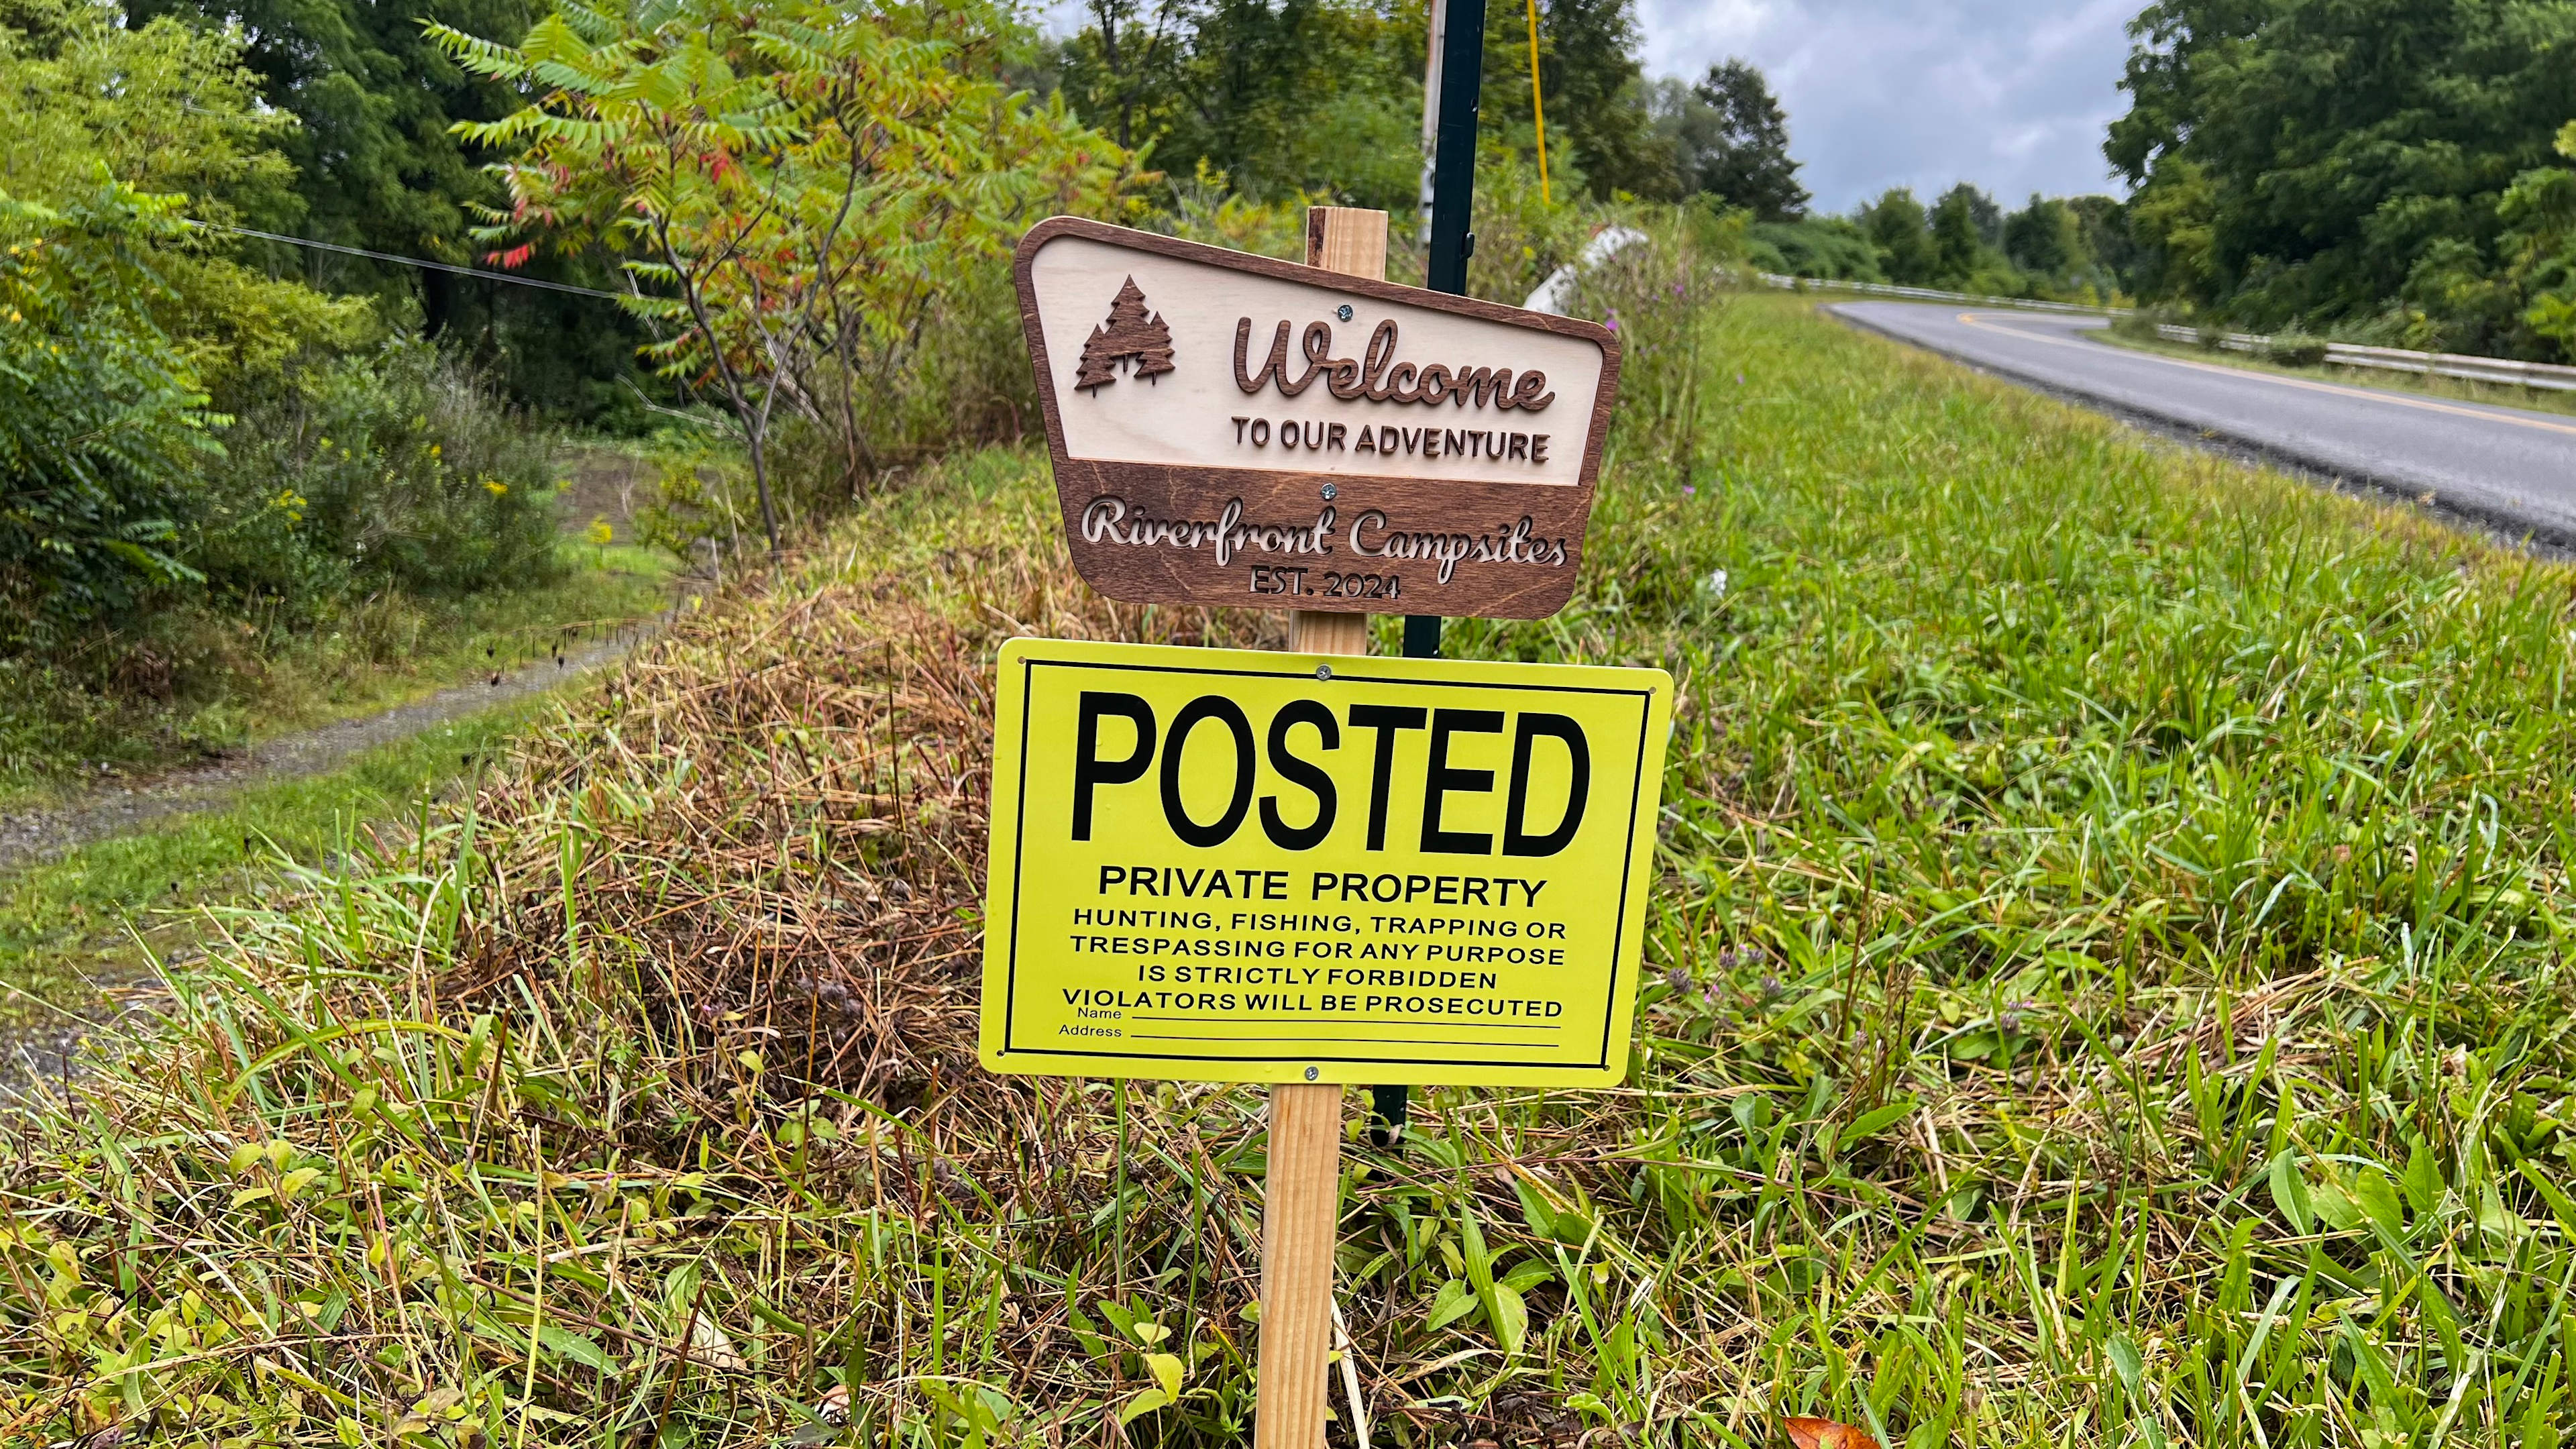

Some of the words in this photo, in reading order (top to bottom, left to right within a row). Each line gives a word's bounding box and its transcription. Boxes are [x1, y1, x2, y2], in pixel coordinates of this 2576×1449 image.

[1233, 318, 1556, 411] Welcome
[1231, 416, 1270, 446] TO
[1281, 421, 1347, 451] OUR
[1355, 425, 1549, 462] ADVENTURE
[1081, 495, 1336, 567] Riverfront
[1350, 509, 1567, 584] Campsites
[1250, 566, 1313, 596] EST.
[1324, 572, 1401, 600] 2024
[1071, 691, 1590, 857] POSTED
[1099, 866, 1288, 900] PRIVATE
[1312, 873, 1547, 907] PROPERTY
[1075, 909, 1220, 931] HUNTING,
[1232, 914, 1360, 934] FISHING,
[1371, 917, 1517, 936] TRAPPING
[1527, 922, 1565, 939] OR
[1070, 936, 1284, 957] TRESPASSING
[1295, 942, 1352, 958] FOR
[1360, 943, 1419, 959] ANY
[1428, 945, 1564, 965] PURPOSE
[1139, 965, 1165, 981] IS
[1175, 967, 1320, 984] STRICTLY
[1328, 969, 1496, 989] FORBIDDEN
[1063, 989, 1235, 1010] VIOLATORS
[1245, 994, 1311, 1010] WILL
[1322, 996, 1356, 1010] BE
[1366, 996, 1562, 1016] PROSECUTED
[1078, 1008, 1121, 1018] Name
[1059, 1025, 1121, 1036] Address
